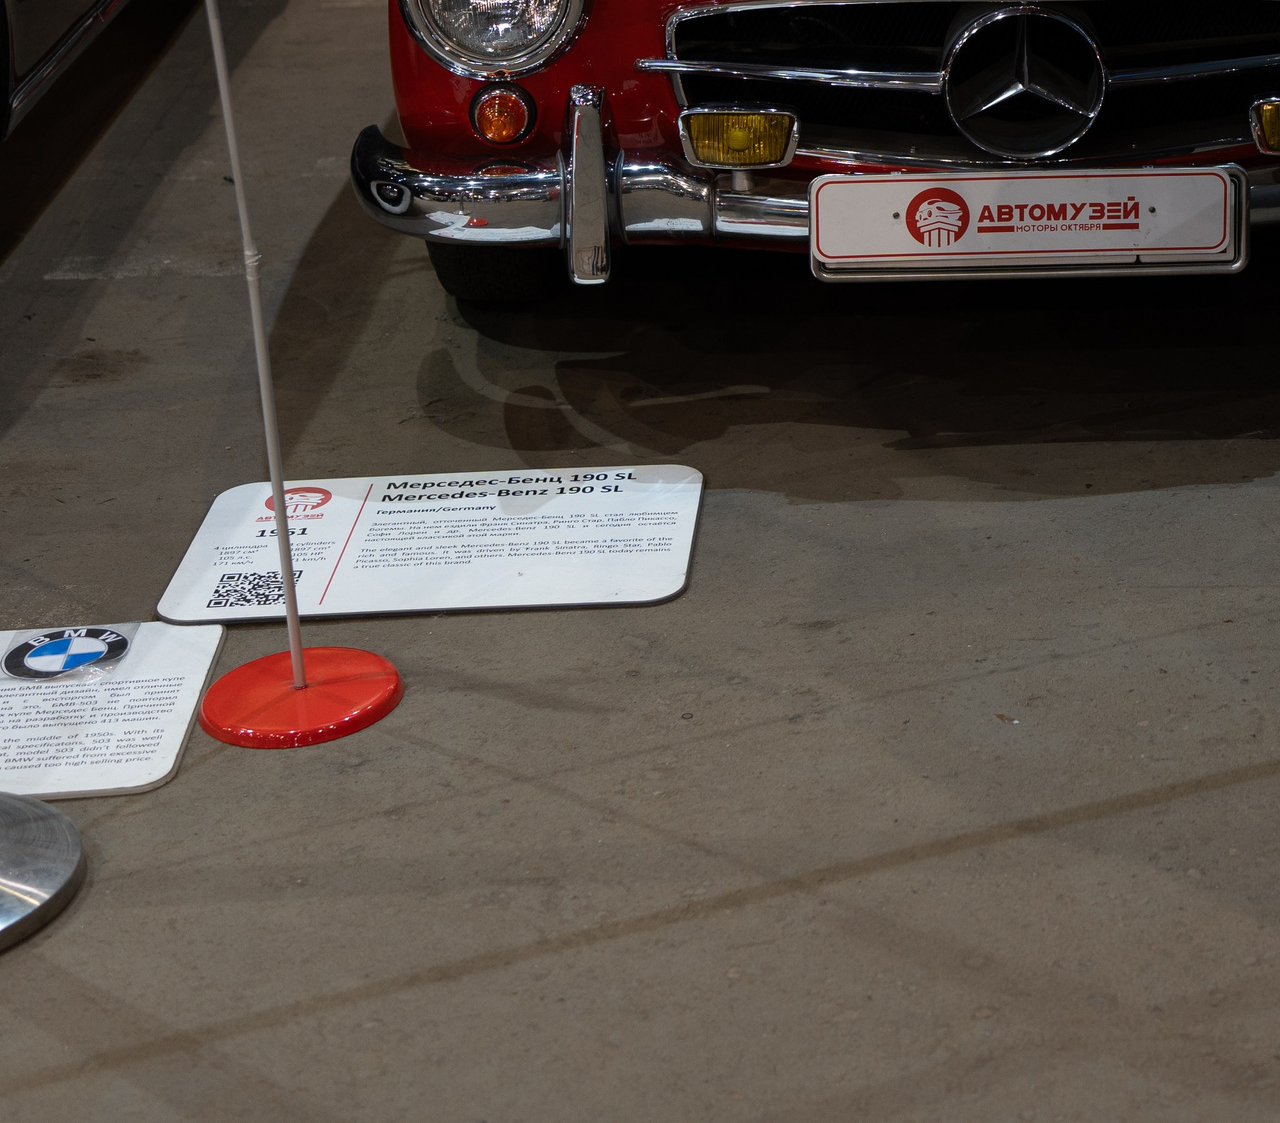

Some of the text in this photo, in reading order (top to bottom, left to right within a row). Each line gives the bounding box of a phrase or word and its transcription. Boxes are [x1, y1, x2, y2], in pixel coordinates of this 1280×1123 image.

[978, 196, 1140, 223] АВТОМУЗЕЙ
[1016, 223, 1101, 233] МОТОРЫ ОКТЯБРЯ
[386, 472, 636, 490] Мерседес-Бенц 190 SL
[381, 485, 623, 502] Mercedes-Benz 190 SL
[376, 505, 496, 515] Германия/Germany
[28, 628, 123, 647] BMW
[16, 741, 85, 749] specificatons,
[115, 741, 160, 749] followed
[36, 753, 79, 761] suffered
